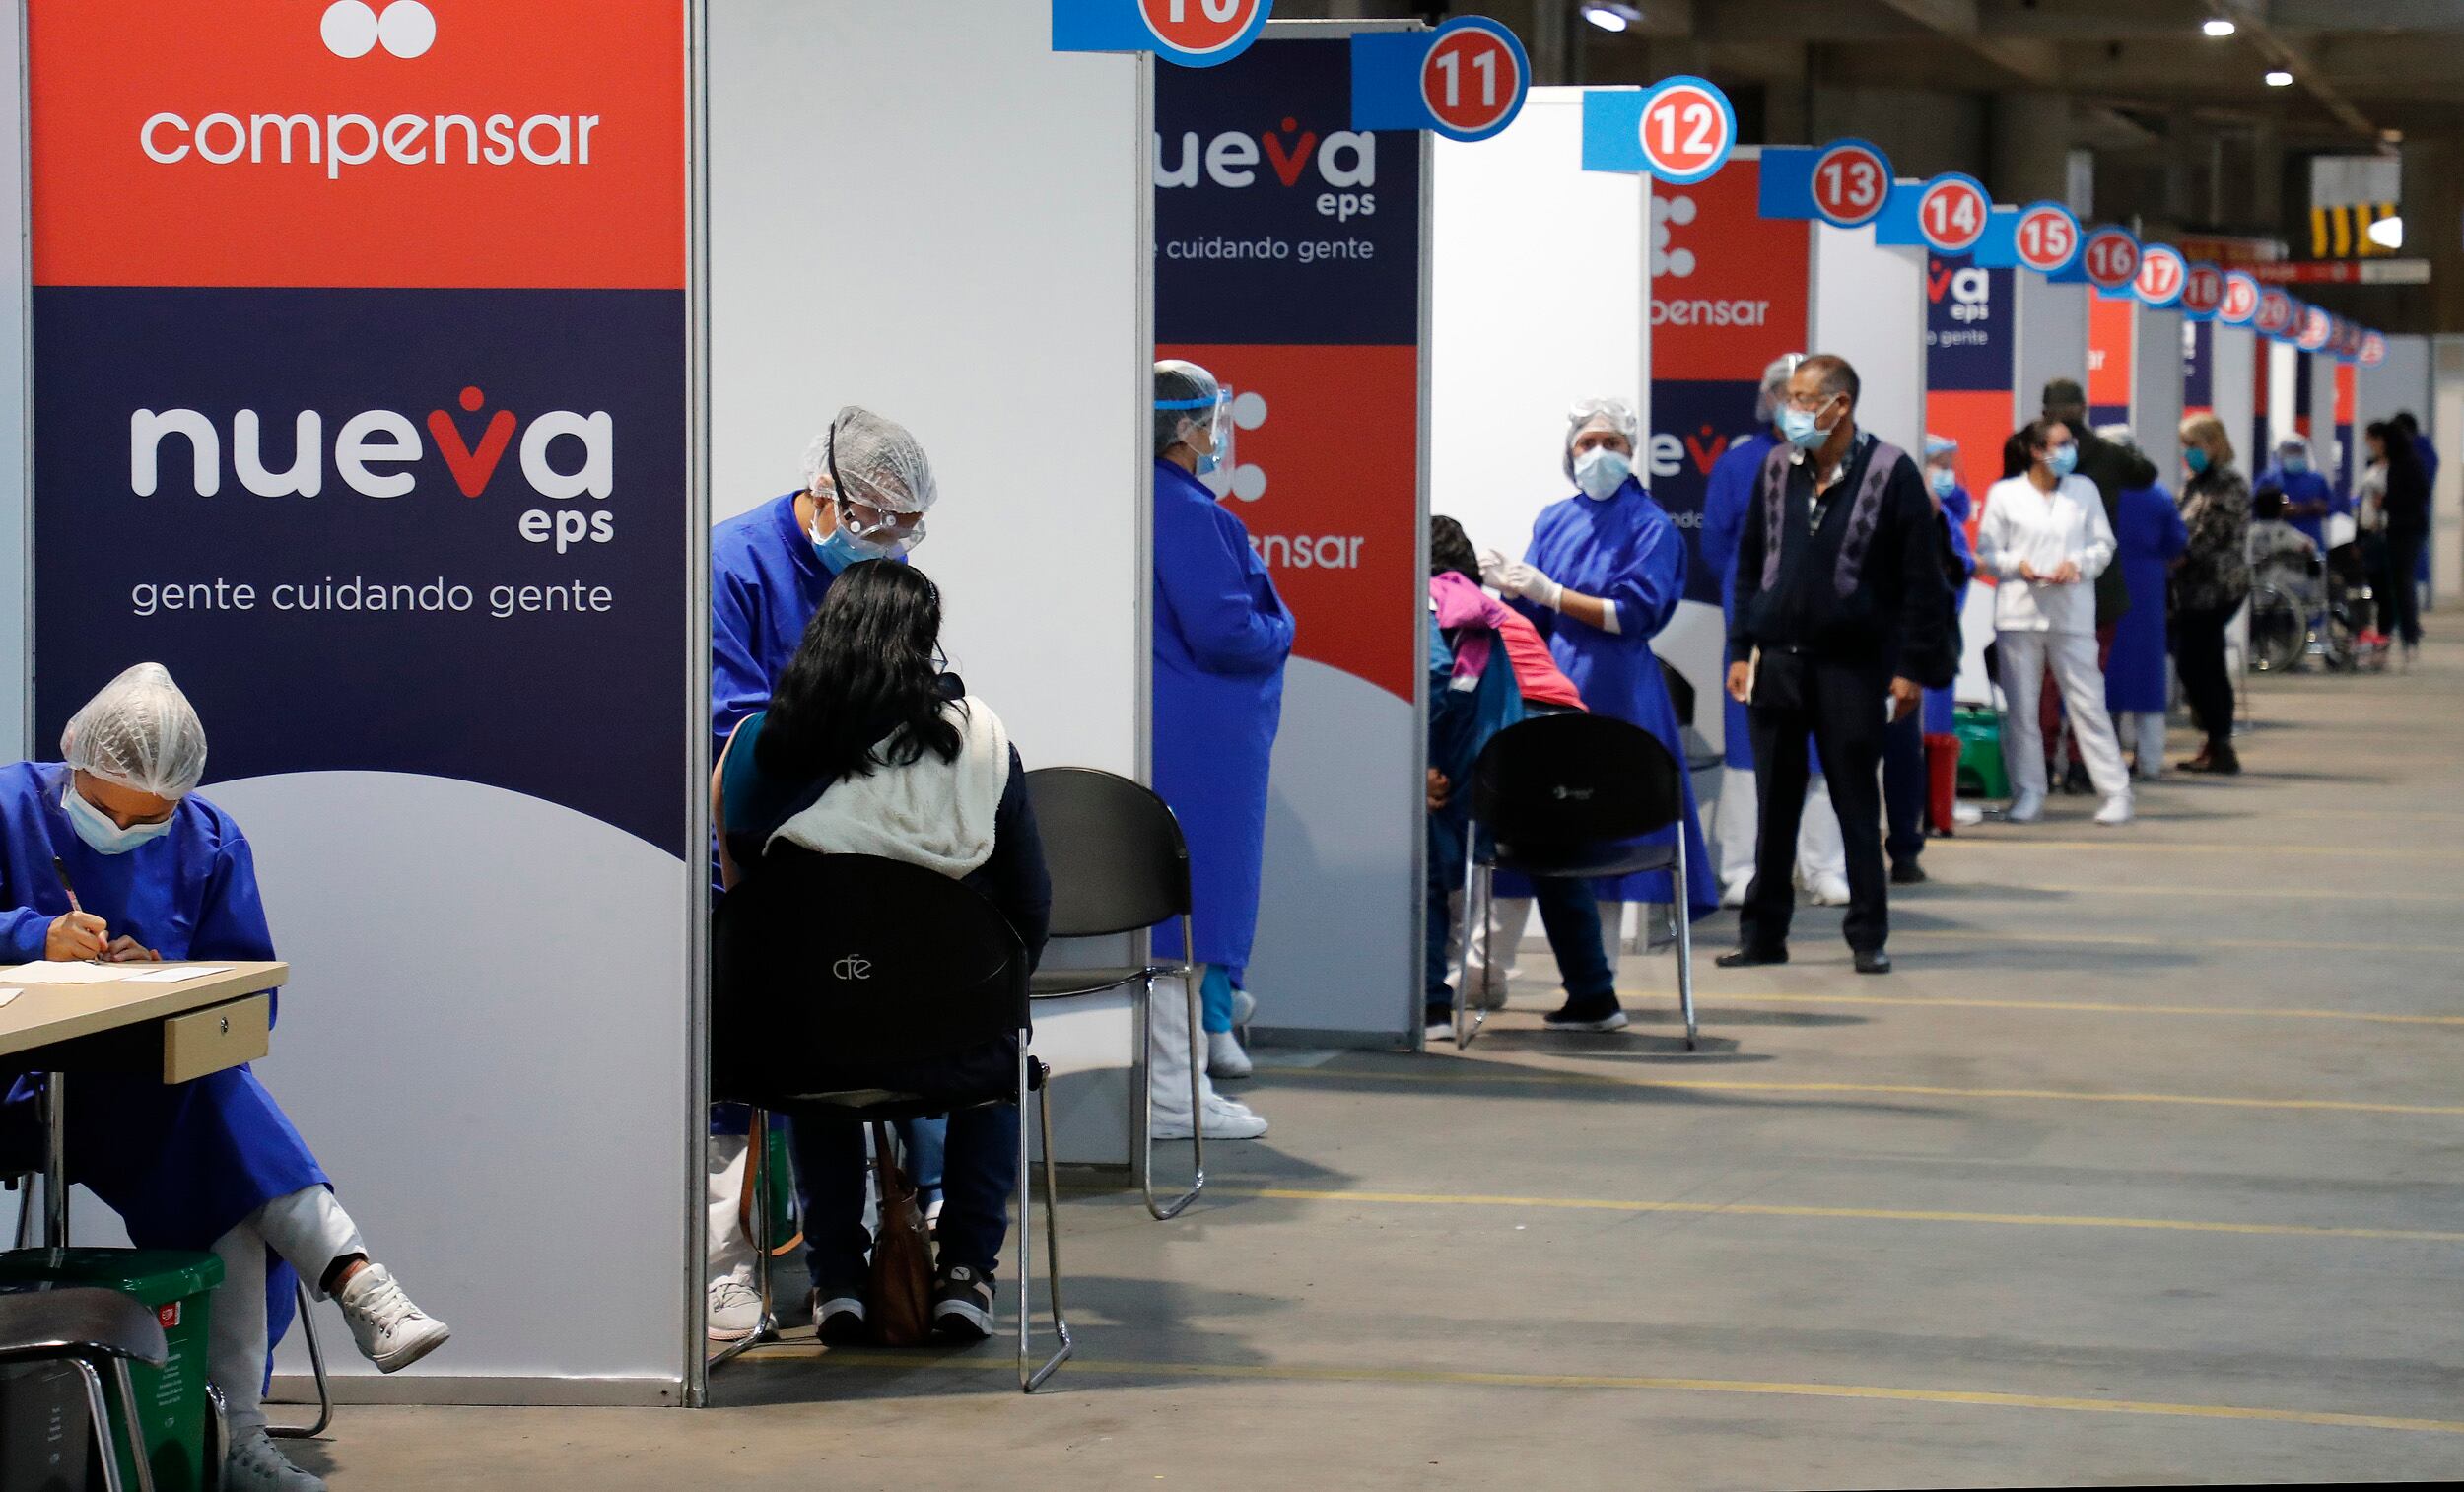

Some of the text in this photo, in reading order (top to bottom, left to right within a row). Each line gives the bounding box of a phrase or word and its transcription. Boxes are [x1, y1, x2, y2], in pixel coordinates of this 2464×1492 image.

[1436, 50, 1497, 107] 11
[140, 112, 599, 179] compensar
[1654, 104, 1714, 155] 12
[1823, 163, 1877, 207] 13
[1317, 193, 1376, 223] eps
[1930, 195, 1976, 235] 14
[1166, 237, 1288, 259] cuidando
[1298, 237, 1374, 263] gente
[2024, 220, 2068, 257] 15
[2093, 241, 2131, 276] 16
[2143, 259, 2175, 292] 17
[131, 385, 613, 499] nueva
[518, 509, 614, 554] eps
[132, 576, 613, 618] gente cuidando gente
